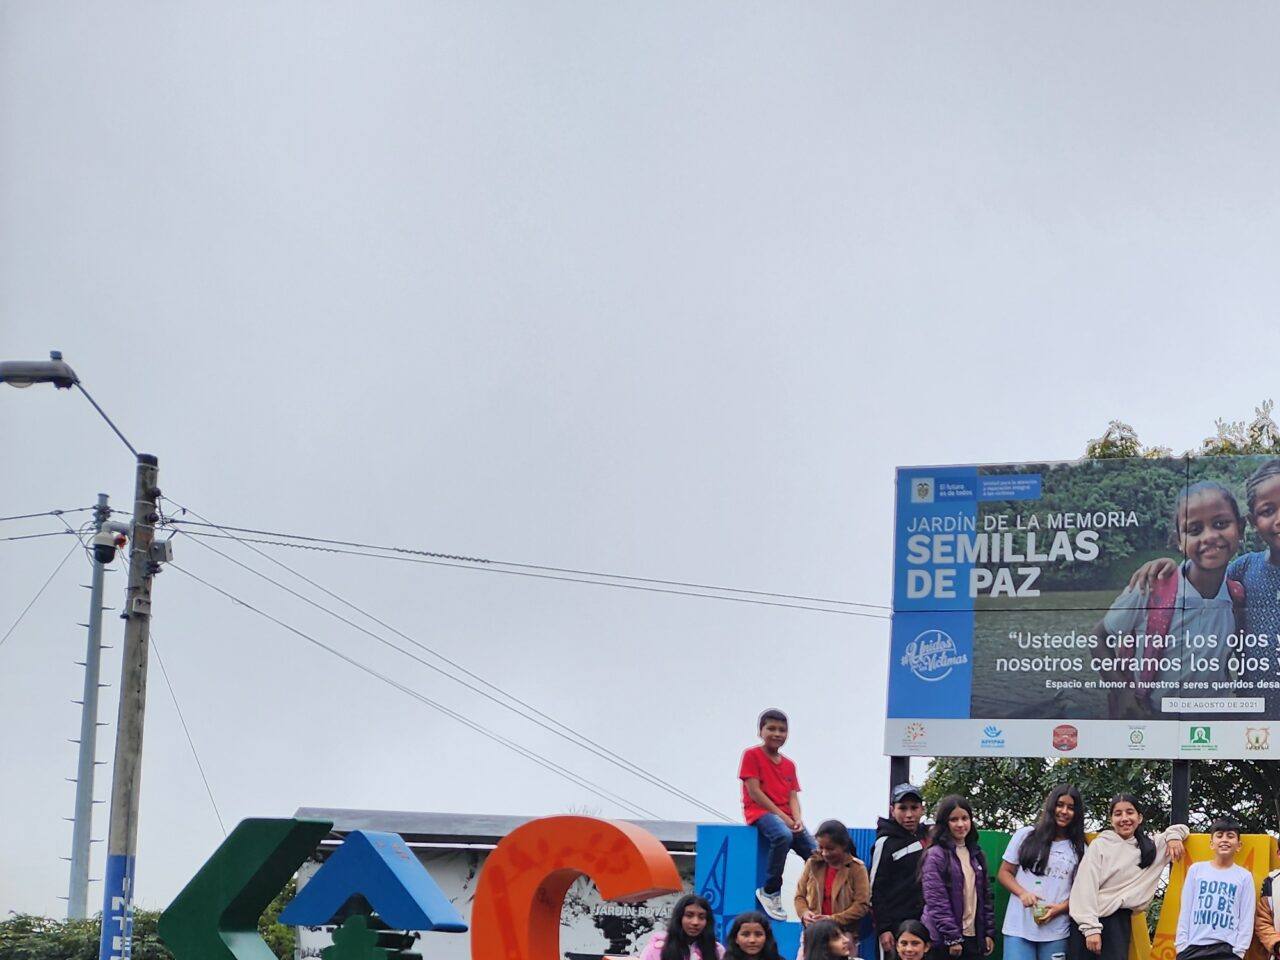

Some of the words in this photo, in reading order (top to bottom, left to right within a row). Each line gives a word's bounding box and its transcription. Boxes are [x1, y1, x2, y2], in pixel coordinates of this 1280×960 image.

[906, 512, 976, 532] JARDÍN
[984, 514, 1008, 530] DE
[1016, 514, 1040, 530] LA
[1048, 511, 1139, 529] MEMORIA
[906, 530, 1100, 564] SEMILLAS
[906, 568, 956, 599] DE
[969, 566, 1041, 598] PAZ
[1106, 630, 1176, 648] cierran
[1185, 630, 1218, 648] los
[1226, 630, 1268, 652] ojos
[996, 655, 1083, 672] nosotros
[1090, 655, 1182, 672] cerramos
[1190, 654, 1220, 672] los
[1228, 652, 1270, 675] ojos
[1046, 680, 1082, 691] Espacio
[1099, 680, 1127, 689] honor
[1138, 680, 1180, 689] nuestros
[1212, 680, 1254, 690] queridos
[1200, 880, 1238, 898] BORN
[1198, 895, 1213, 909] TO
[1218, 896, 1235, 914] BE
[1193, 910, 1234, 930] UNIQUE
